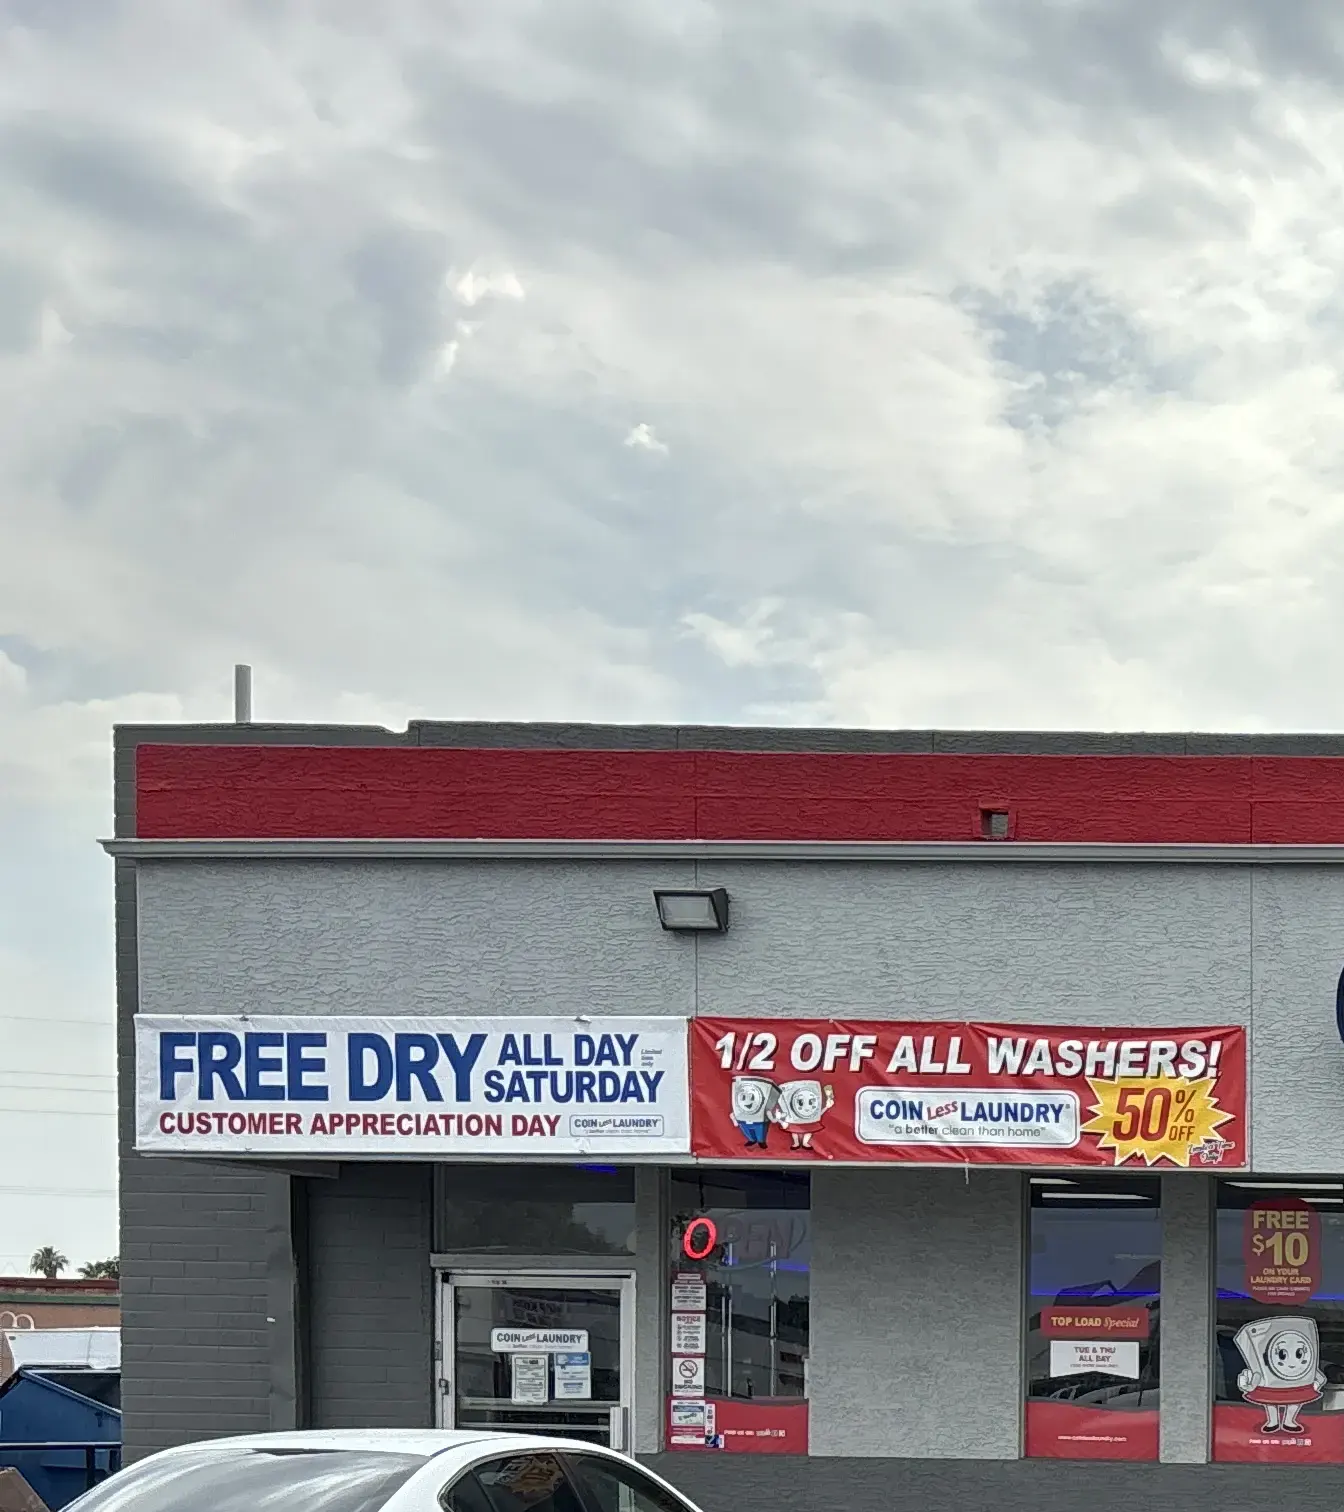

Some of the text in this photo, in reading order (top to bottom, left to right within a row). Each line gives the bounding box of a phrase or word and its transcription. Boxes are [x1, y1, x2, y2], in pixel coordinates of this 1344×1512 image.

[497, 1033, 639, 1066] ALL DAY
[714, 1032, 1223, 1079] 1/2 OFF ALL WASHERS!
[159, 1032, 488, 1102] FREE DRY
[484, 1070, 665, 1103] SATURDAY
[870, 1100, 1065, 1123] COIN Less LAUNDRY
[159, 1112, 561, 1137] CUSTOMER APPRECIATION DAY
[574, 1119, 597, 1128] COIN
[613, 1119, 658, 1128] LAUNDRY
[905, 1124, 938, 1135] better
[941, 1125, 974, 1136] clean
[978, 1126, 1004, 1137] than
[1169, 1126, 1195, 1141] OFF
[1253, 1210, 1309, 1229] FREE
[1252, 1231, 1308, 1266] $10
[1051, 1317, 1139, 1330] TOP LOAD Special
[497, 1333, 520, 1343] COIN
[536, 1334, 582, 1343] LAUNDRY
